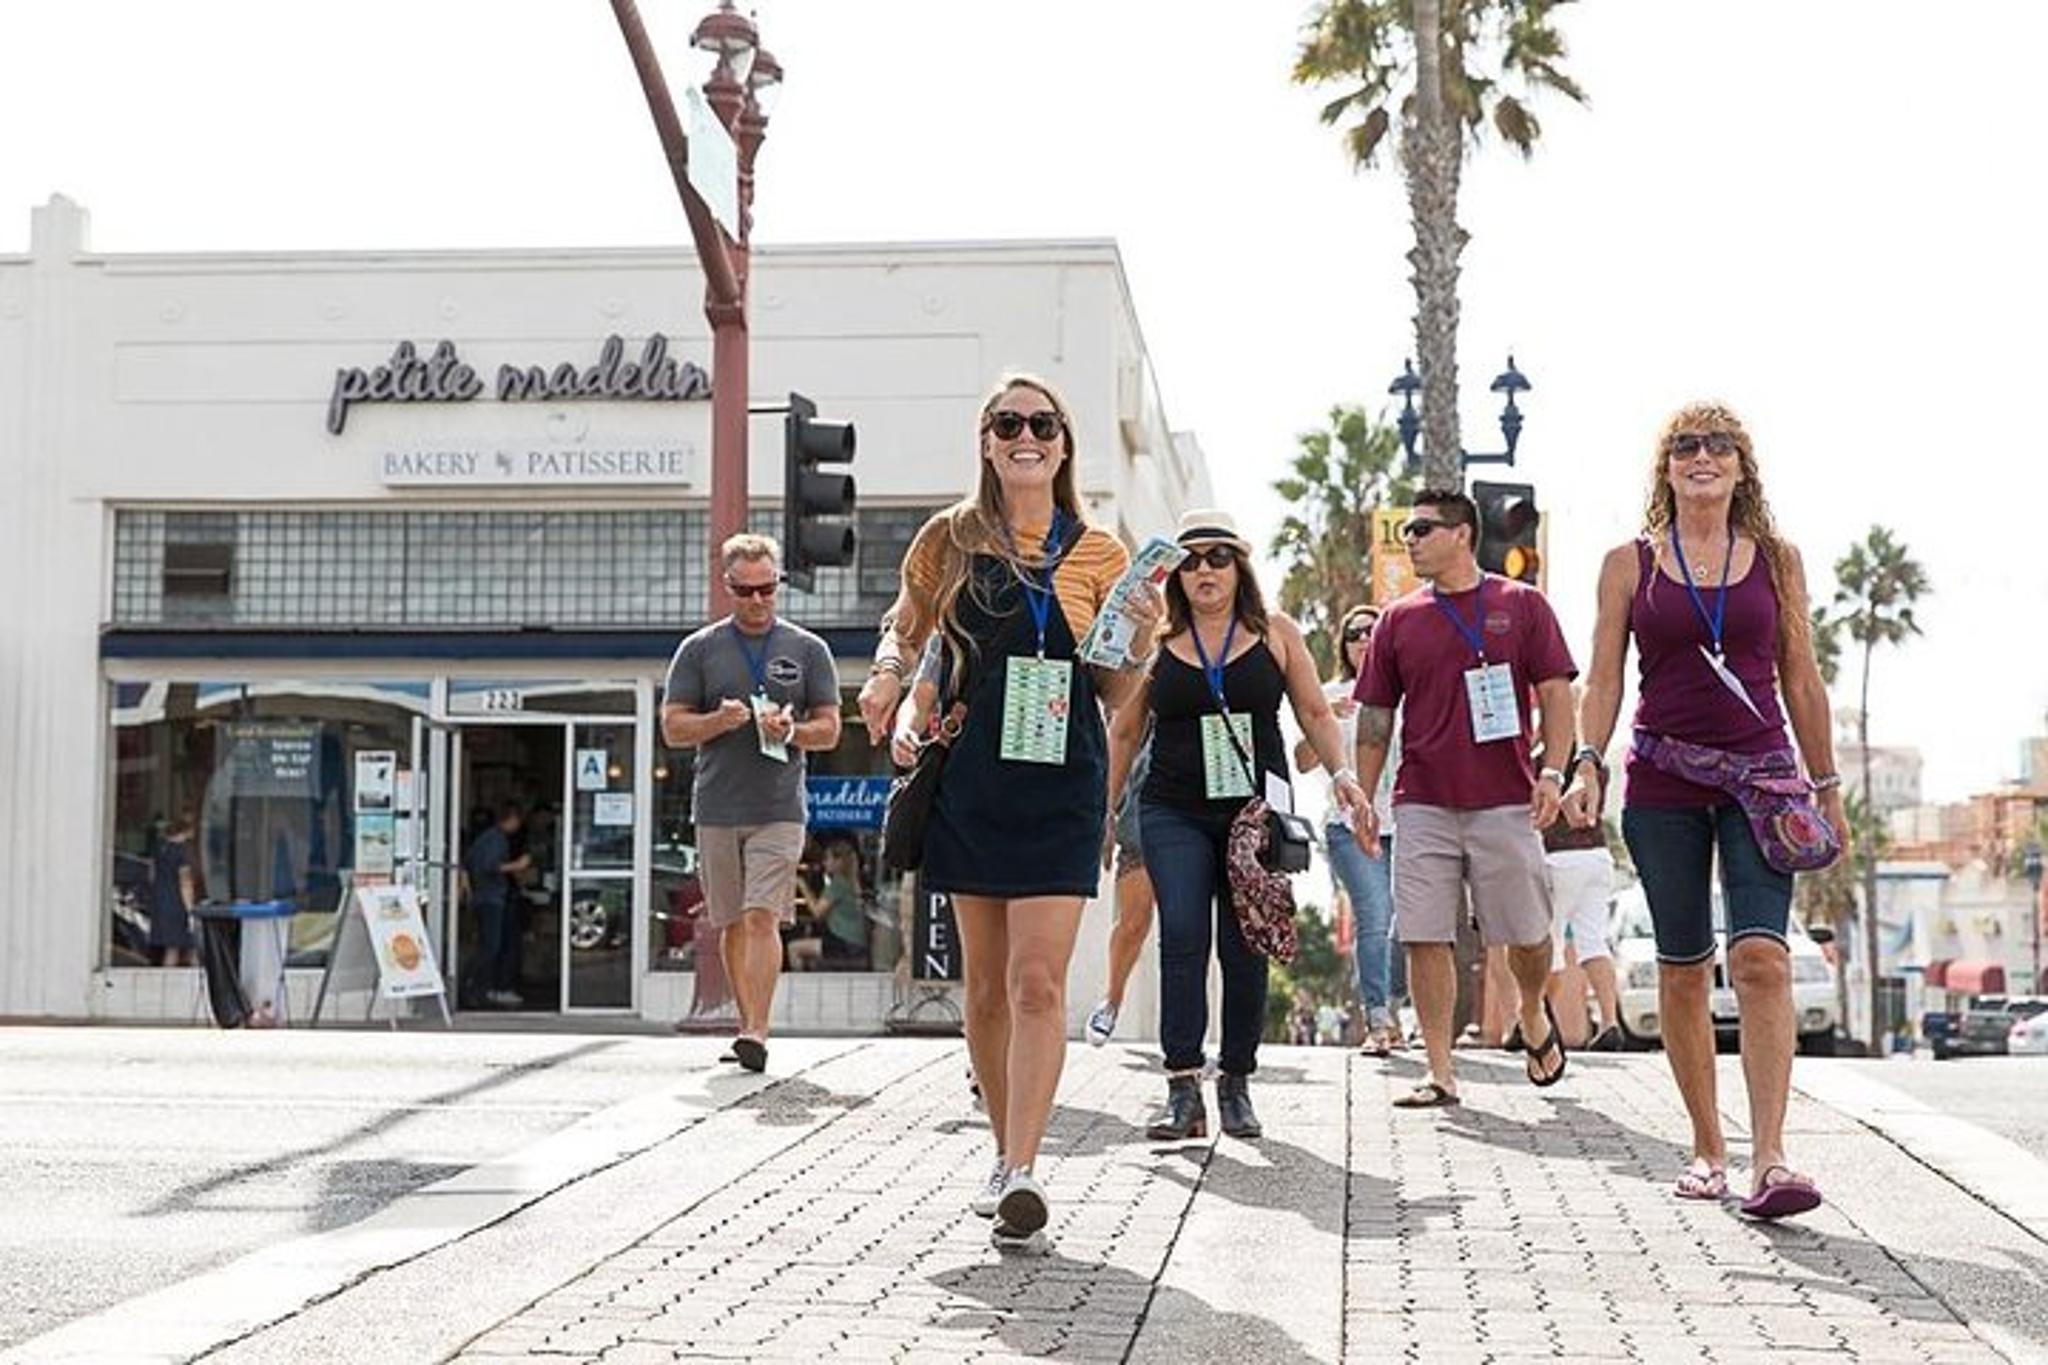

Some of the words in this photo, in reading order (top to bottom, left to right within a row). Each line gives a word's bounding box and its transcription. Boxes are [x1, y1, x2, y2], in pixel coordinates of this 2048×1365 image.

[327, 340, 484, 435] petite
[497, 333, 713, 401] madelin
[384, 452, 479, 475] BAKERY
[527, 450, 682, 475] PATISSERIE
[583, 755, 600, 775] A
[925, 892, 948, 978] PEN
